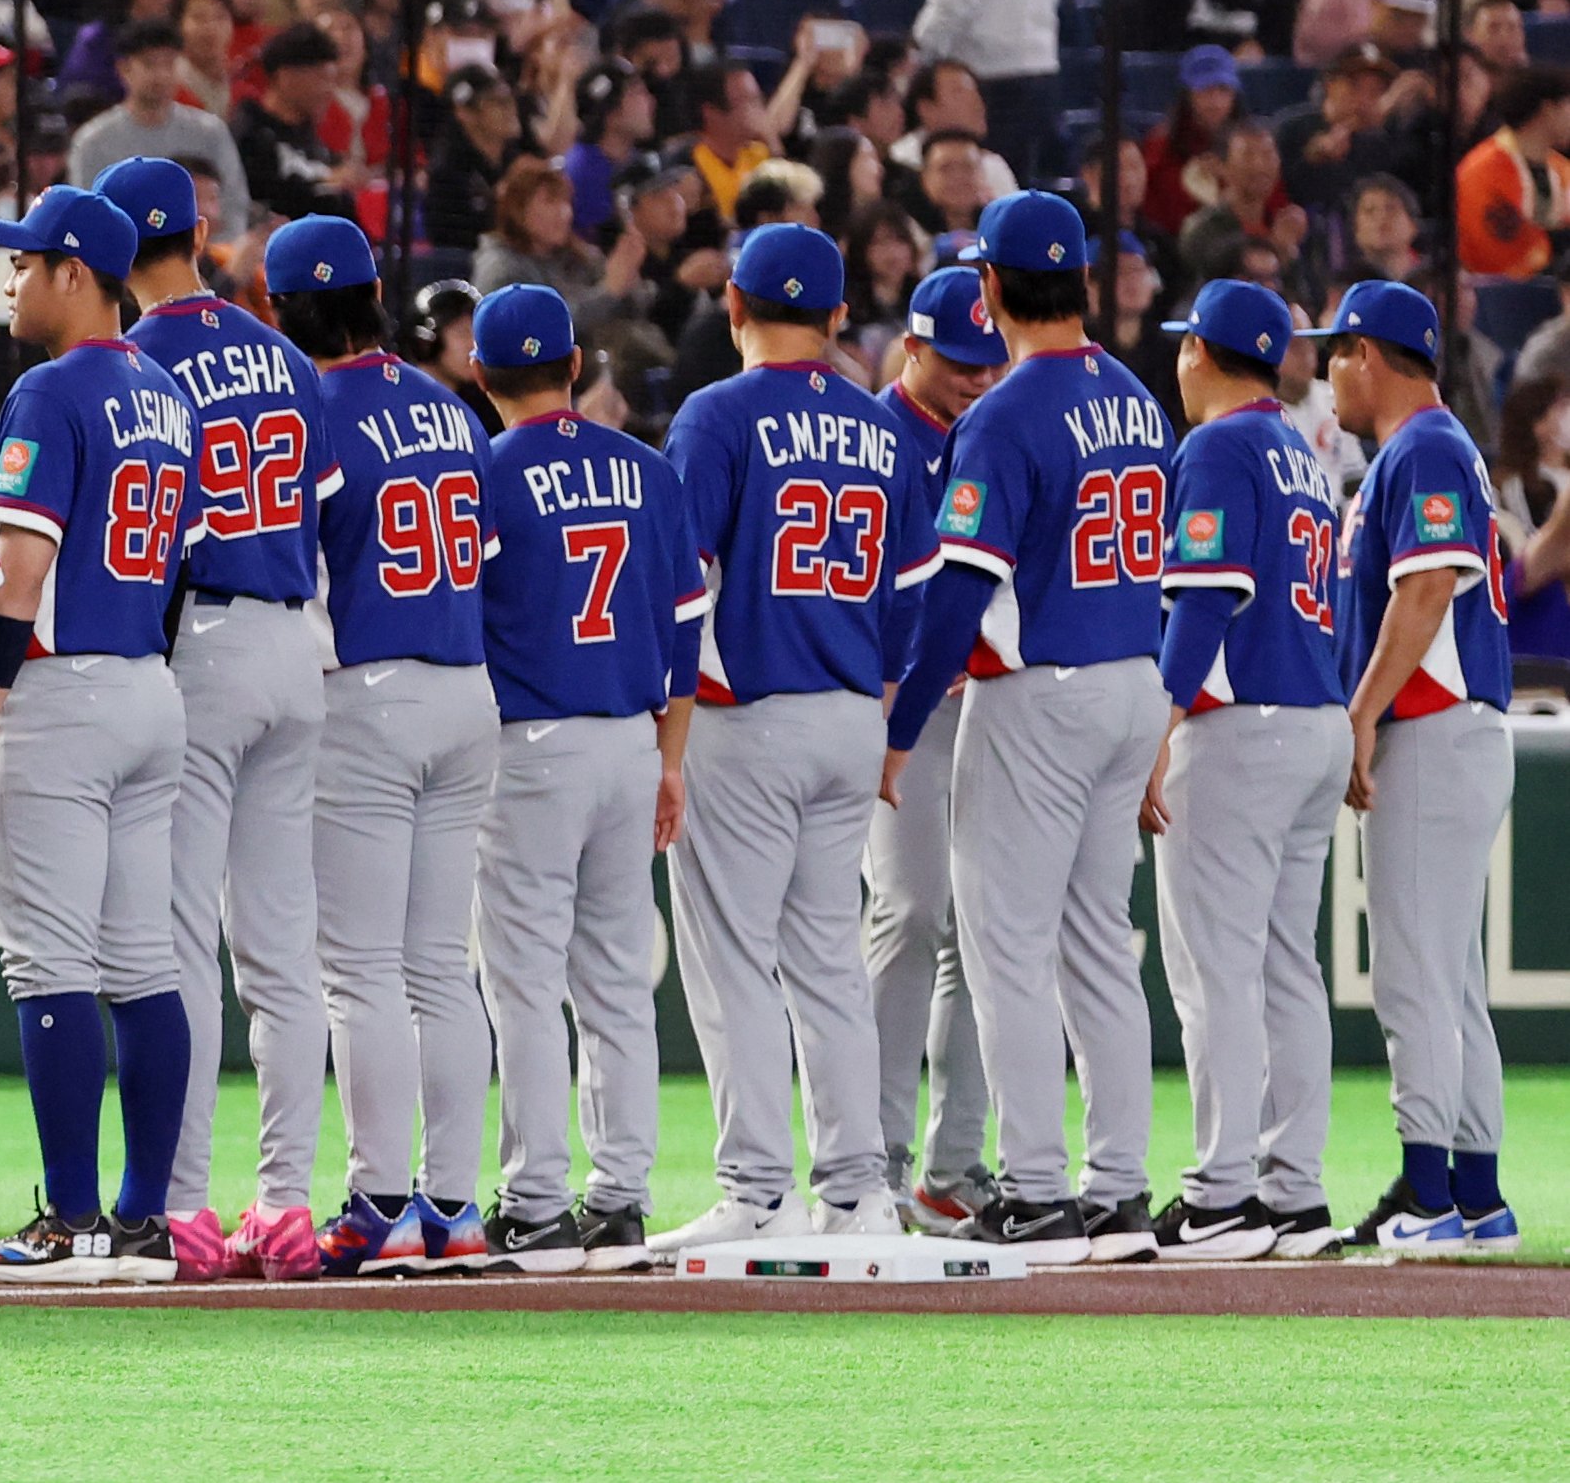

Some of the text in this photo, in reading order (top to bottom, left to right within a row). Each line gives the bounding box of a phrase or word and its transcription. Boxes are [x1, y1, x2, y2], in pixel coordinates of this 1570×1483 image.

[172, 344, 295, 409] T.C.SHA
[358, 402, 474, 463] Y.L.SUN
[199, 408, 307, 541] 92
[523, 457, 643, 516] P.C.LIU
[756, 411, 897, 478] C.M.PENG
[103, 459, 186, 585] 88
[376, 471, 482, 598] 96
[562, 520, 629, 644] 7
[771, 478, 888, 603] 23
[1071, 464, 1166, 590] 28
[1288, 507, 1334, 636] 31
[72, 1233, 112, 1256] 88
